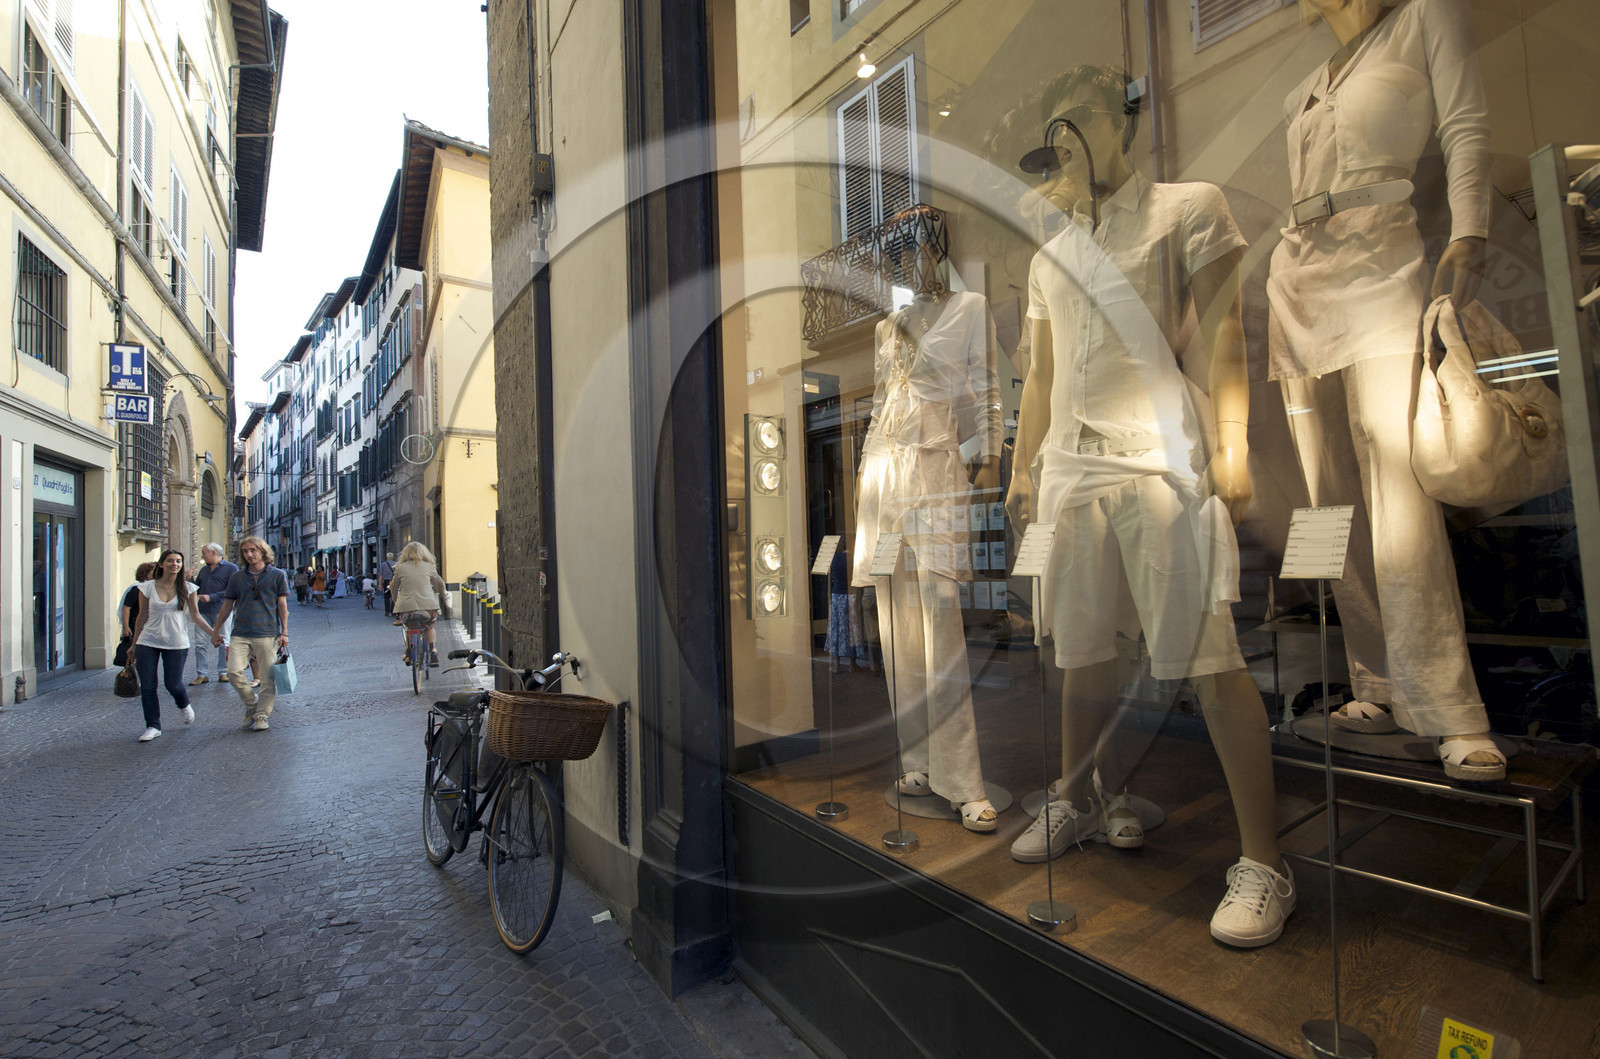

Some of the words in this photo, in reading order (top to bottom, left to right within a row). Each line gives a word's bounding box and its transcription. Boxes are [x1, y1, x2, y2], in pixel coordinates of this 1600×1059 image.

[114, 345, 140, 376] T
[117, 397, 148, 413] BAR
[121, 412, 148, 420] QUADRIFOGLIO
[42, 476, 73, 494] Quadrifoglio
[1448, 1025, 1460, 1039] TAX
[1461, 1031, 1488, 1050] REFUND
